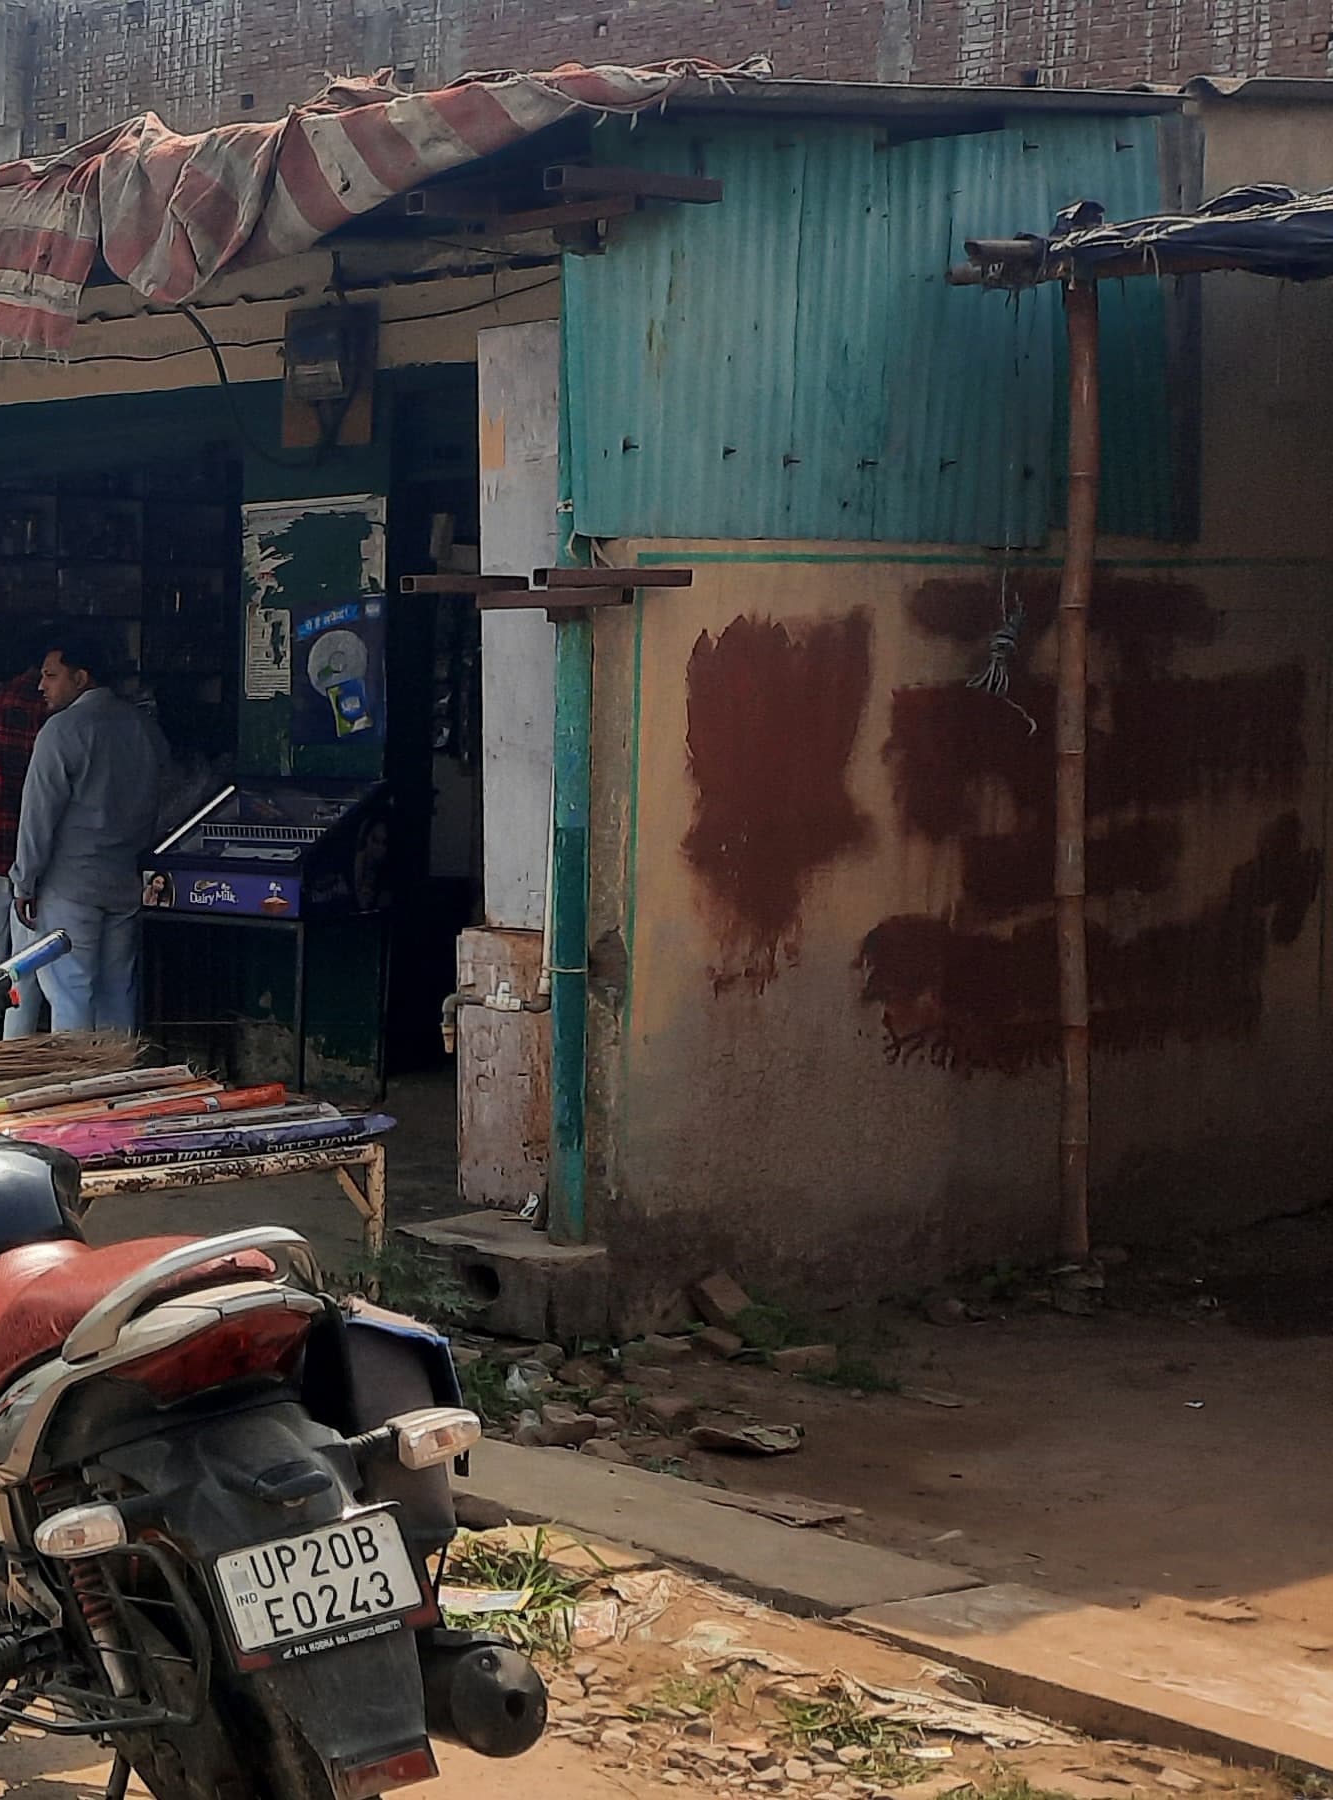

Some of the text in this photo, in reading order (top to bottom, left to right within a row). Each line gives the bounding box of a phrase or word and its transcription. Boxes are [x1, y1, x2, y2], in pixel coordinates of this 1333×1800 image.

[189, 889, 237, 906] Dairy Milk
[248, 1525, 380, 1590] UP20B
[236, 1592, 259, 1608] IND
[264, 1571, 395, 1639] E0243
